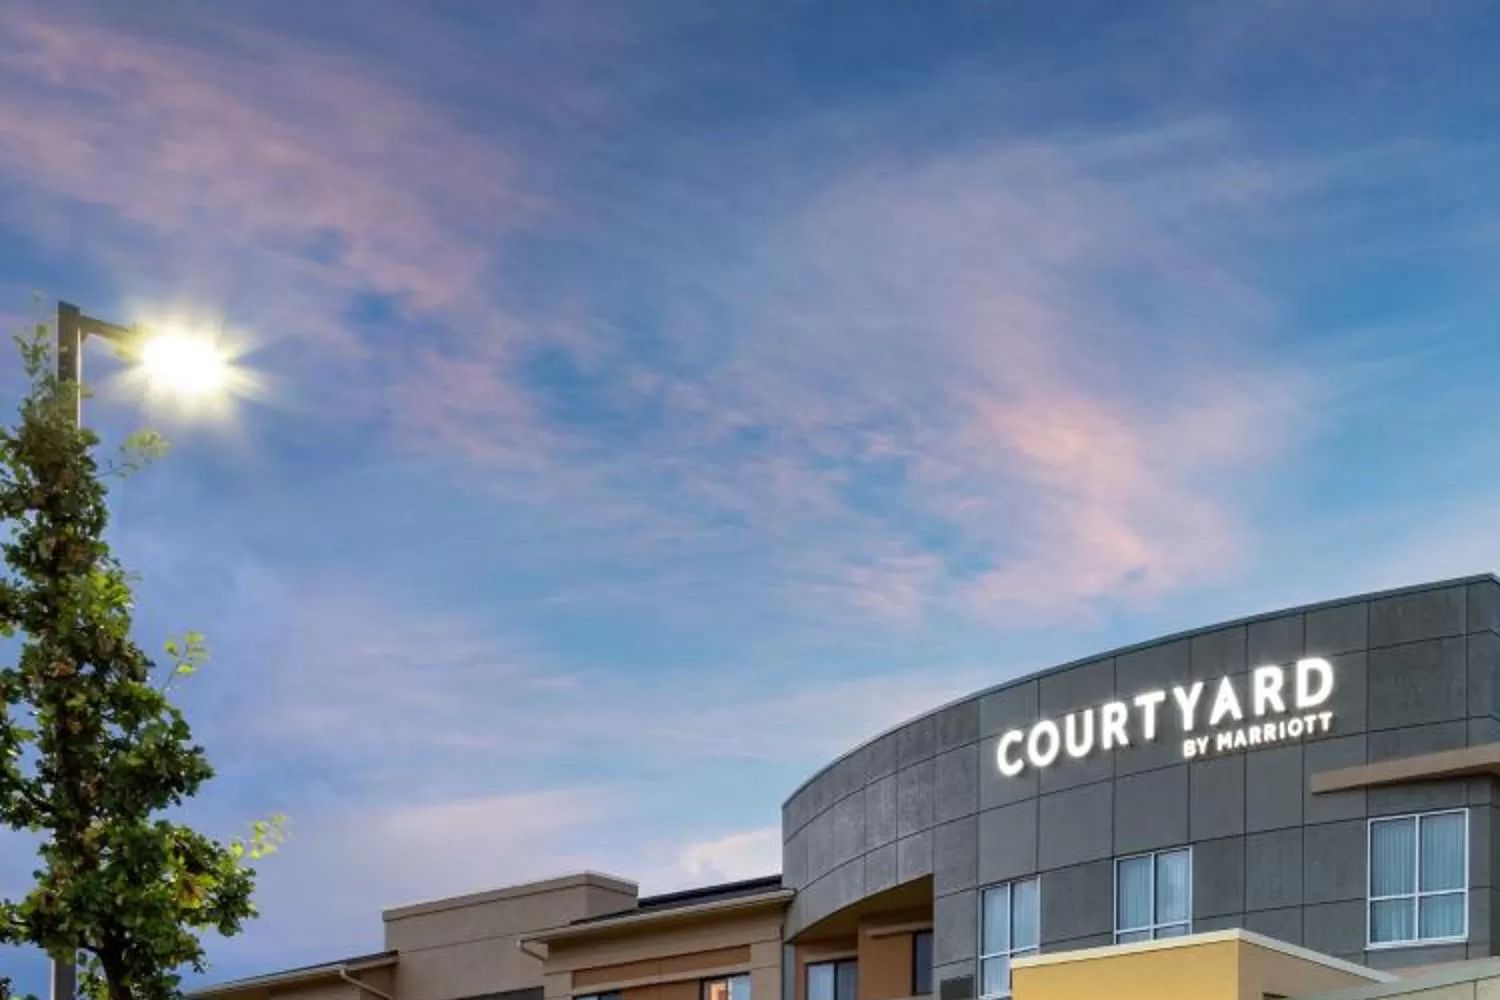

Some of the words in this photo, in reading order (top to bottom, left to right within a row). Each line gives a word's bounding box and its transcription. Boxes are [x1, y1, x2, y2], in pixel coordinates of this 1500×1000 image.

[995, 656, 1335, 778] COURTYARD
[1182, 735, 1210, 759] BY
[1216, 711, 1333, 752] MARRIOTT
